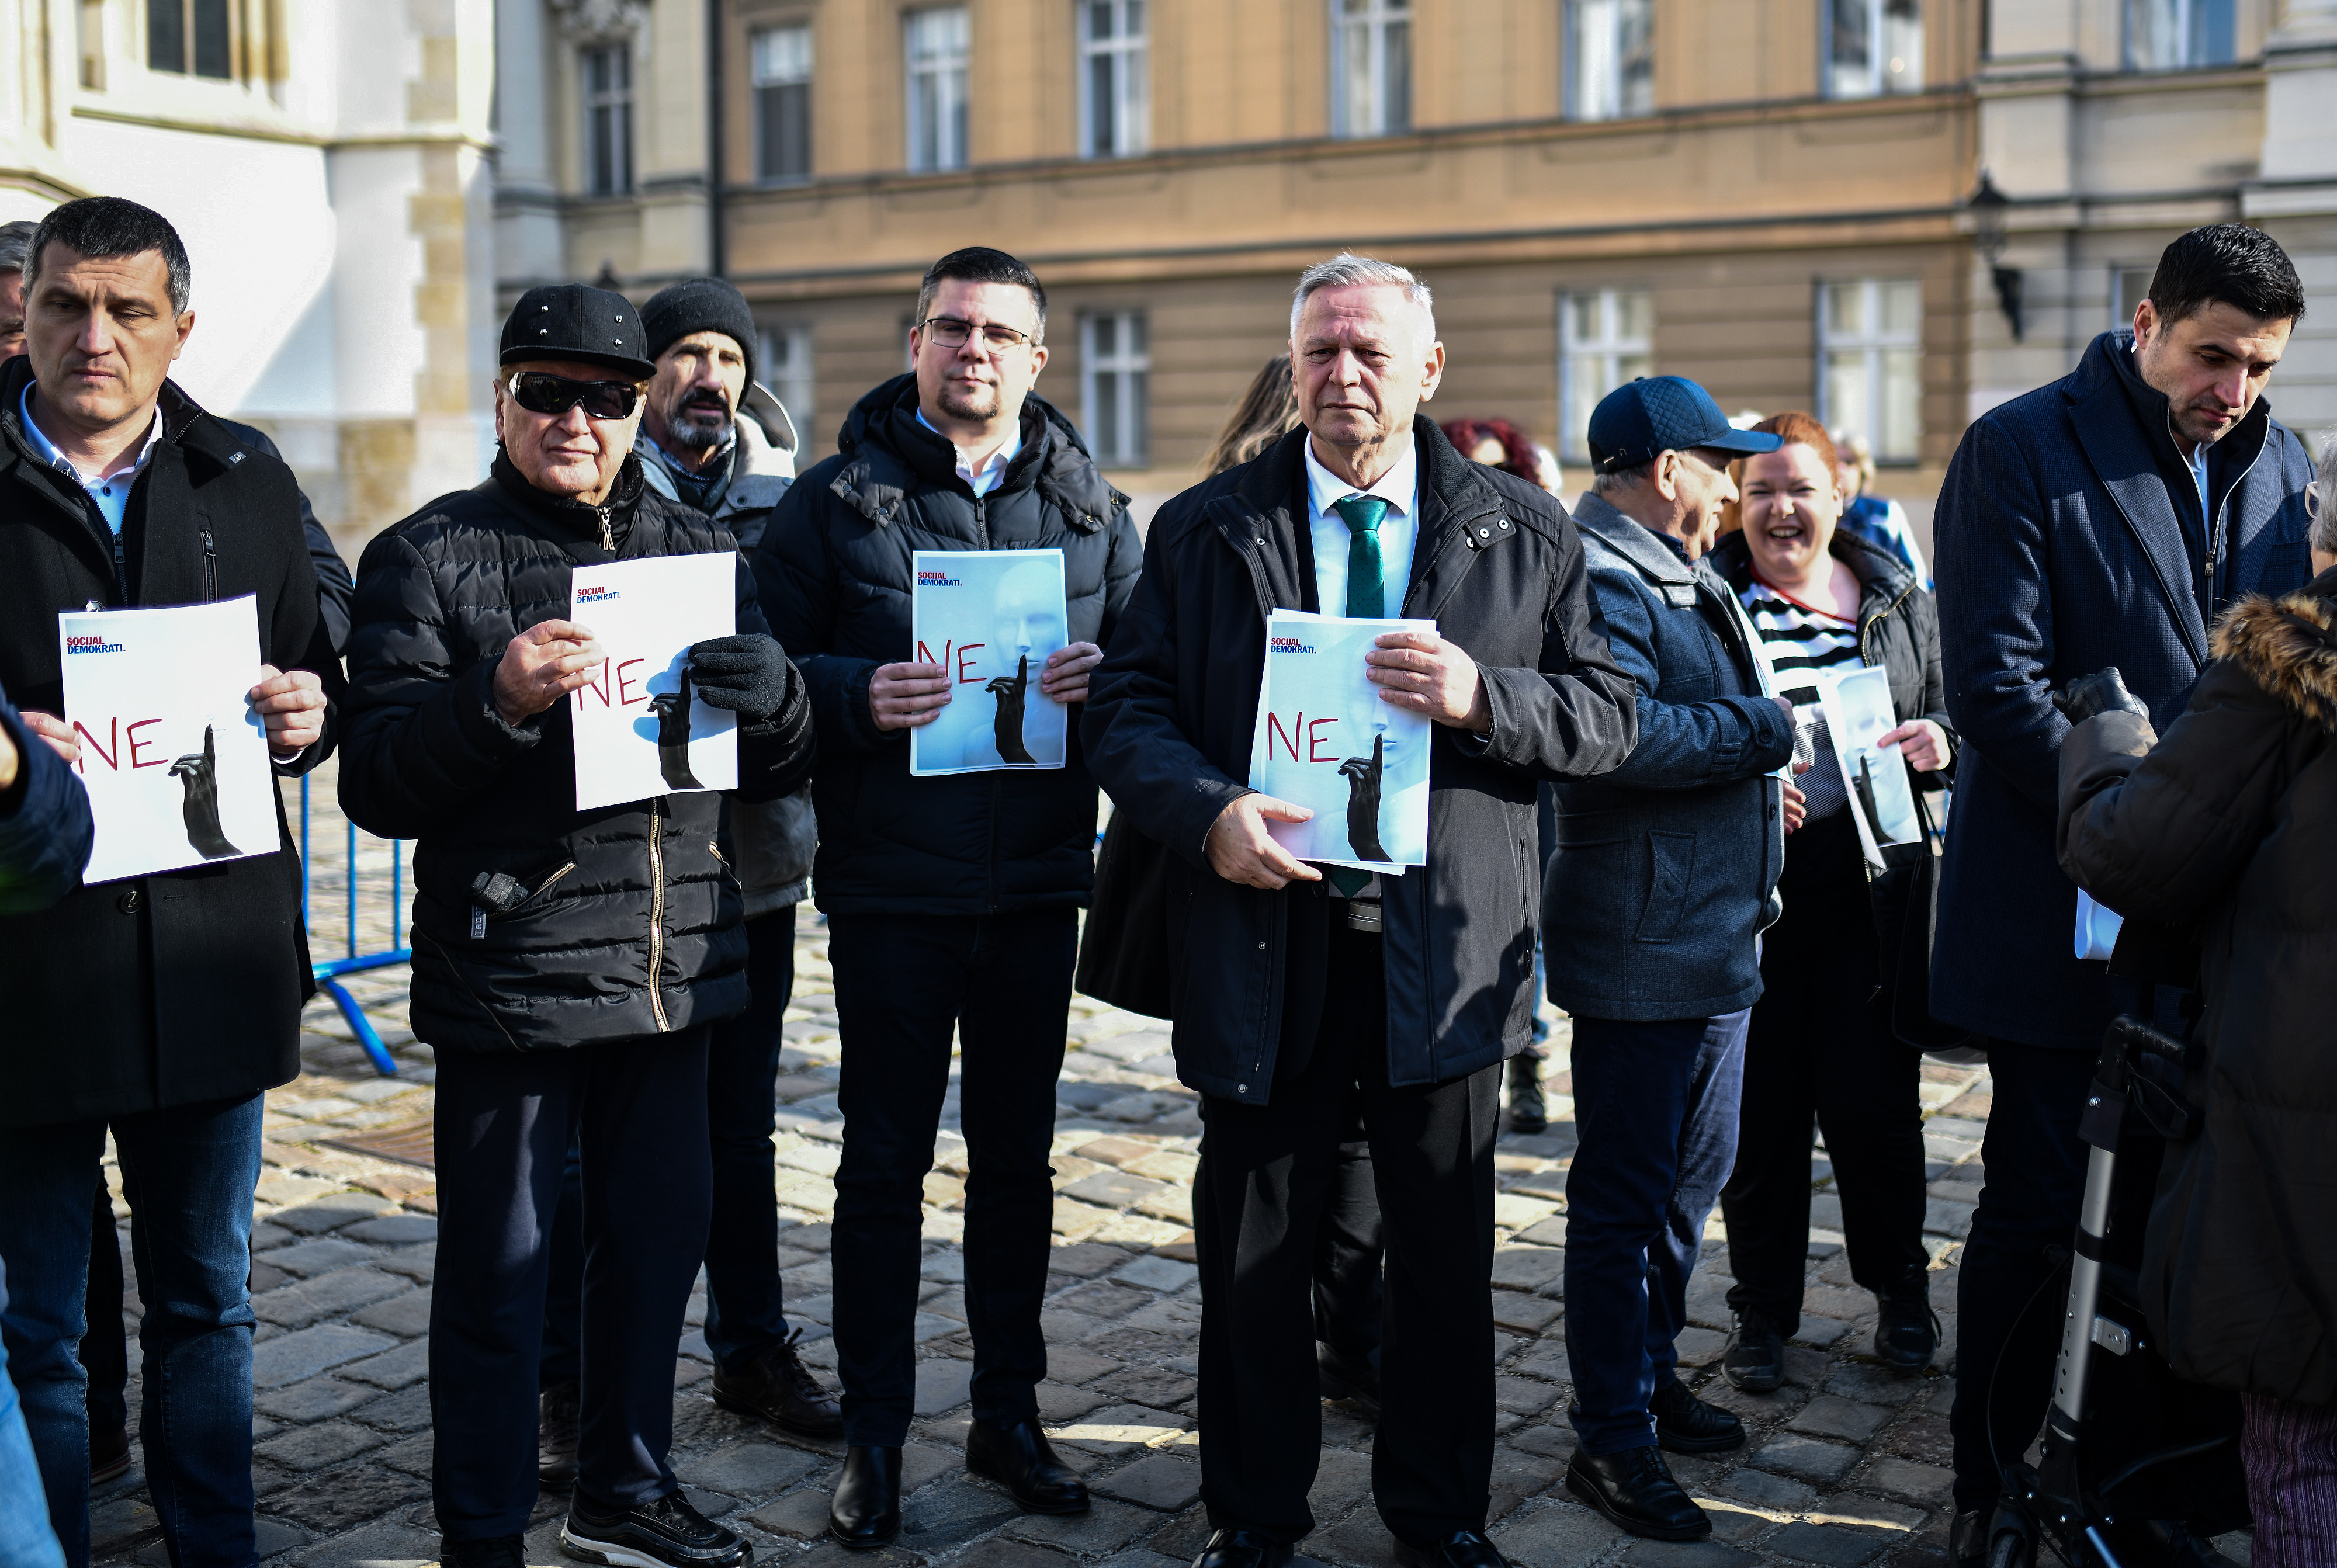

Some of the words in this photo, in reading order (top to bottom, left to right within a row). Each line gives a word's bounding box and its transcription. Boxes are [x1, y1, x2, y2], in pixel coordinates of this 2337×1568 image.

[577, 587, 606, 596] SOCIJAL
[577, 592, 621, 603] DEMOKRATI.
[67, 636, 105, 646] SOCIJAL
[1271, 637, 1301, 646] SOCIJAL
[67, 644, 126, 654] DEMOKRATI.
[1271, 645, 1316, 654] DEMOKRATI.
[918, 639, 987, 684] NE
[577, 657, 648, 711] NE
[1268, 711, 1340, 763] NE
[72, 716, 169, 775] NE
